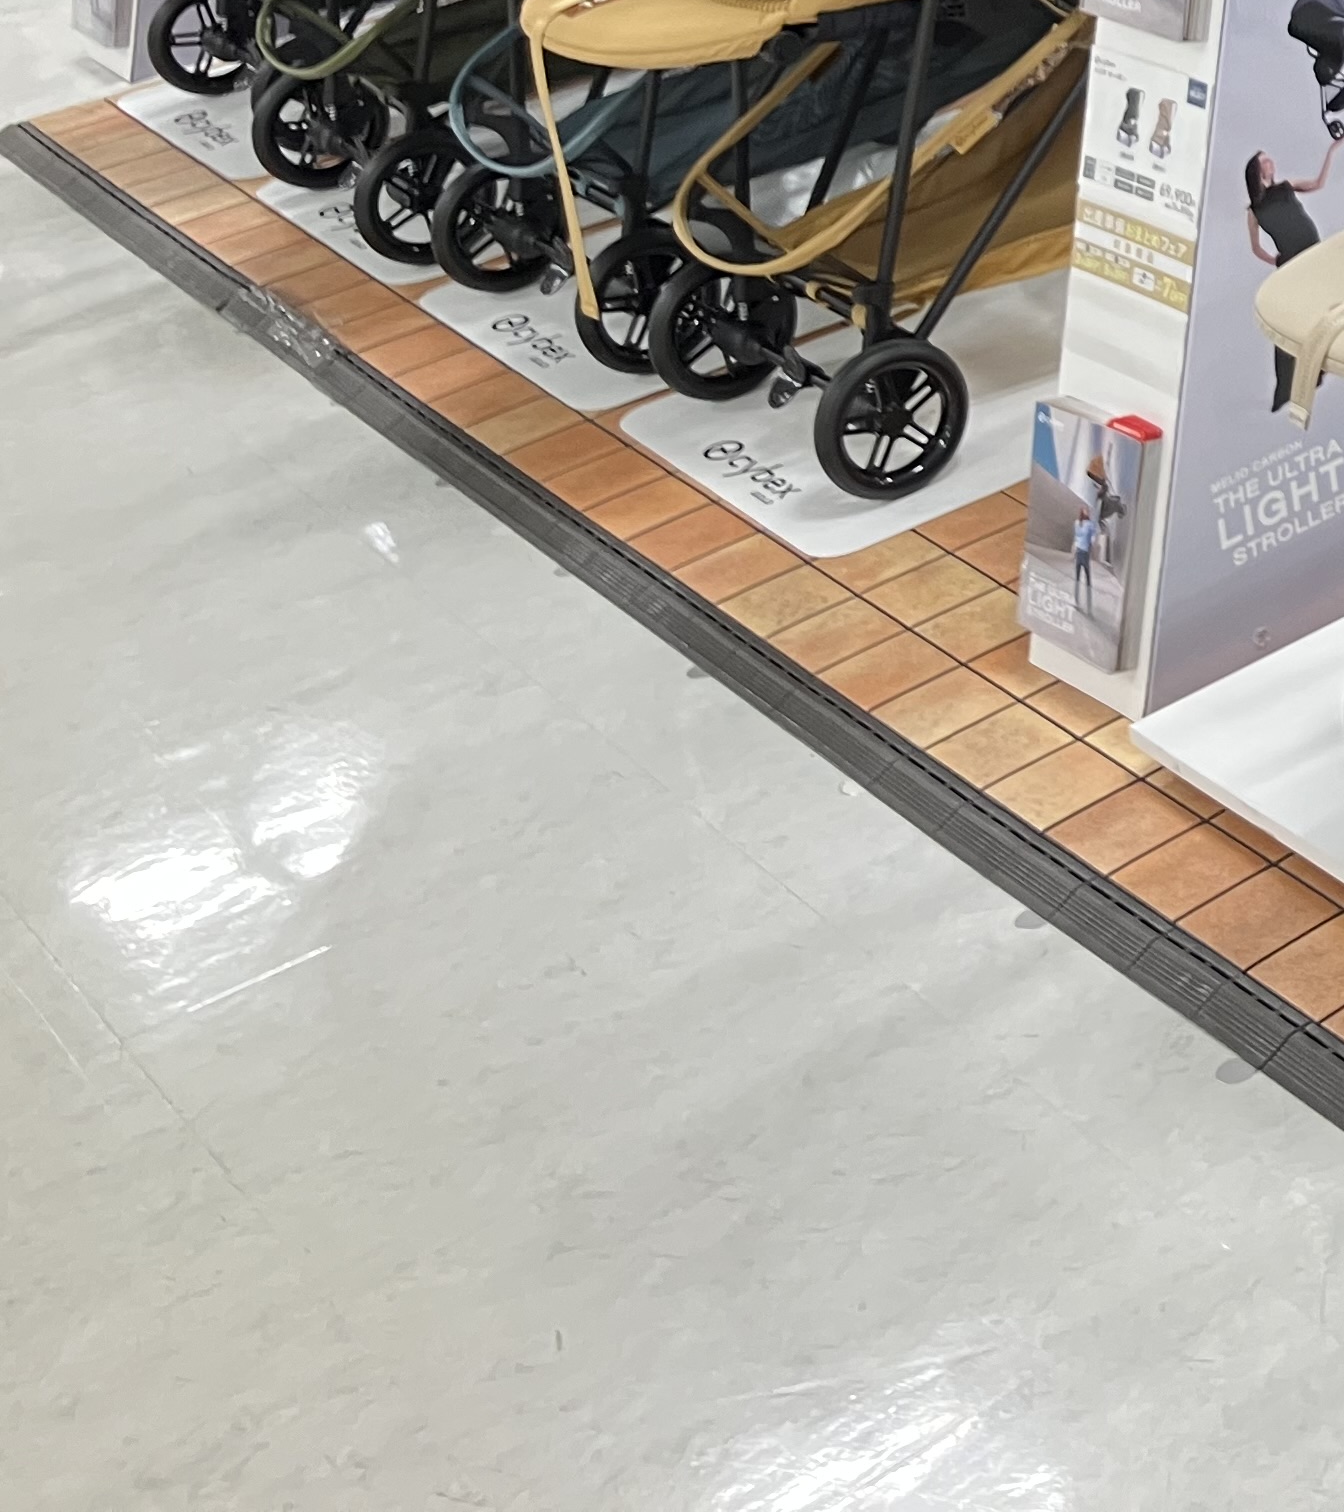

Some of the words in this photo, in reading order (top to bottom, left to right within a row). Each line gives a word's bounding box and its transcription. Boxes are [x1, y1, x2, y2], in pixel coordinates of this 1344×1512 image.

[733, 448, 801, 502] cybex
[1213, 477, 1260, 514] THE
[1267, 439, 1343, 486] ULTRA
[1217, 456, 1344, 550] LIGHT
